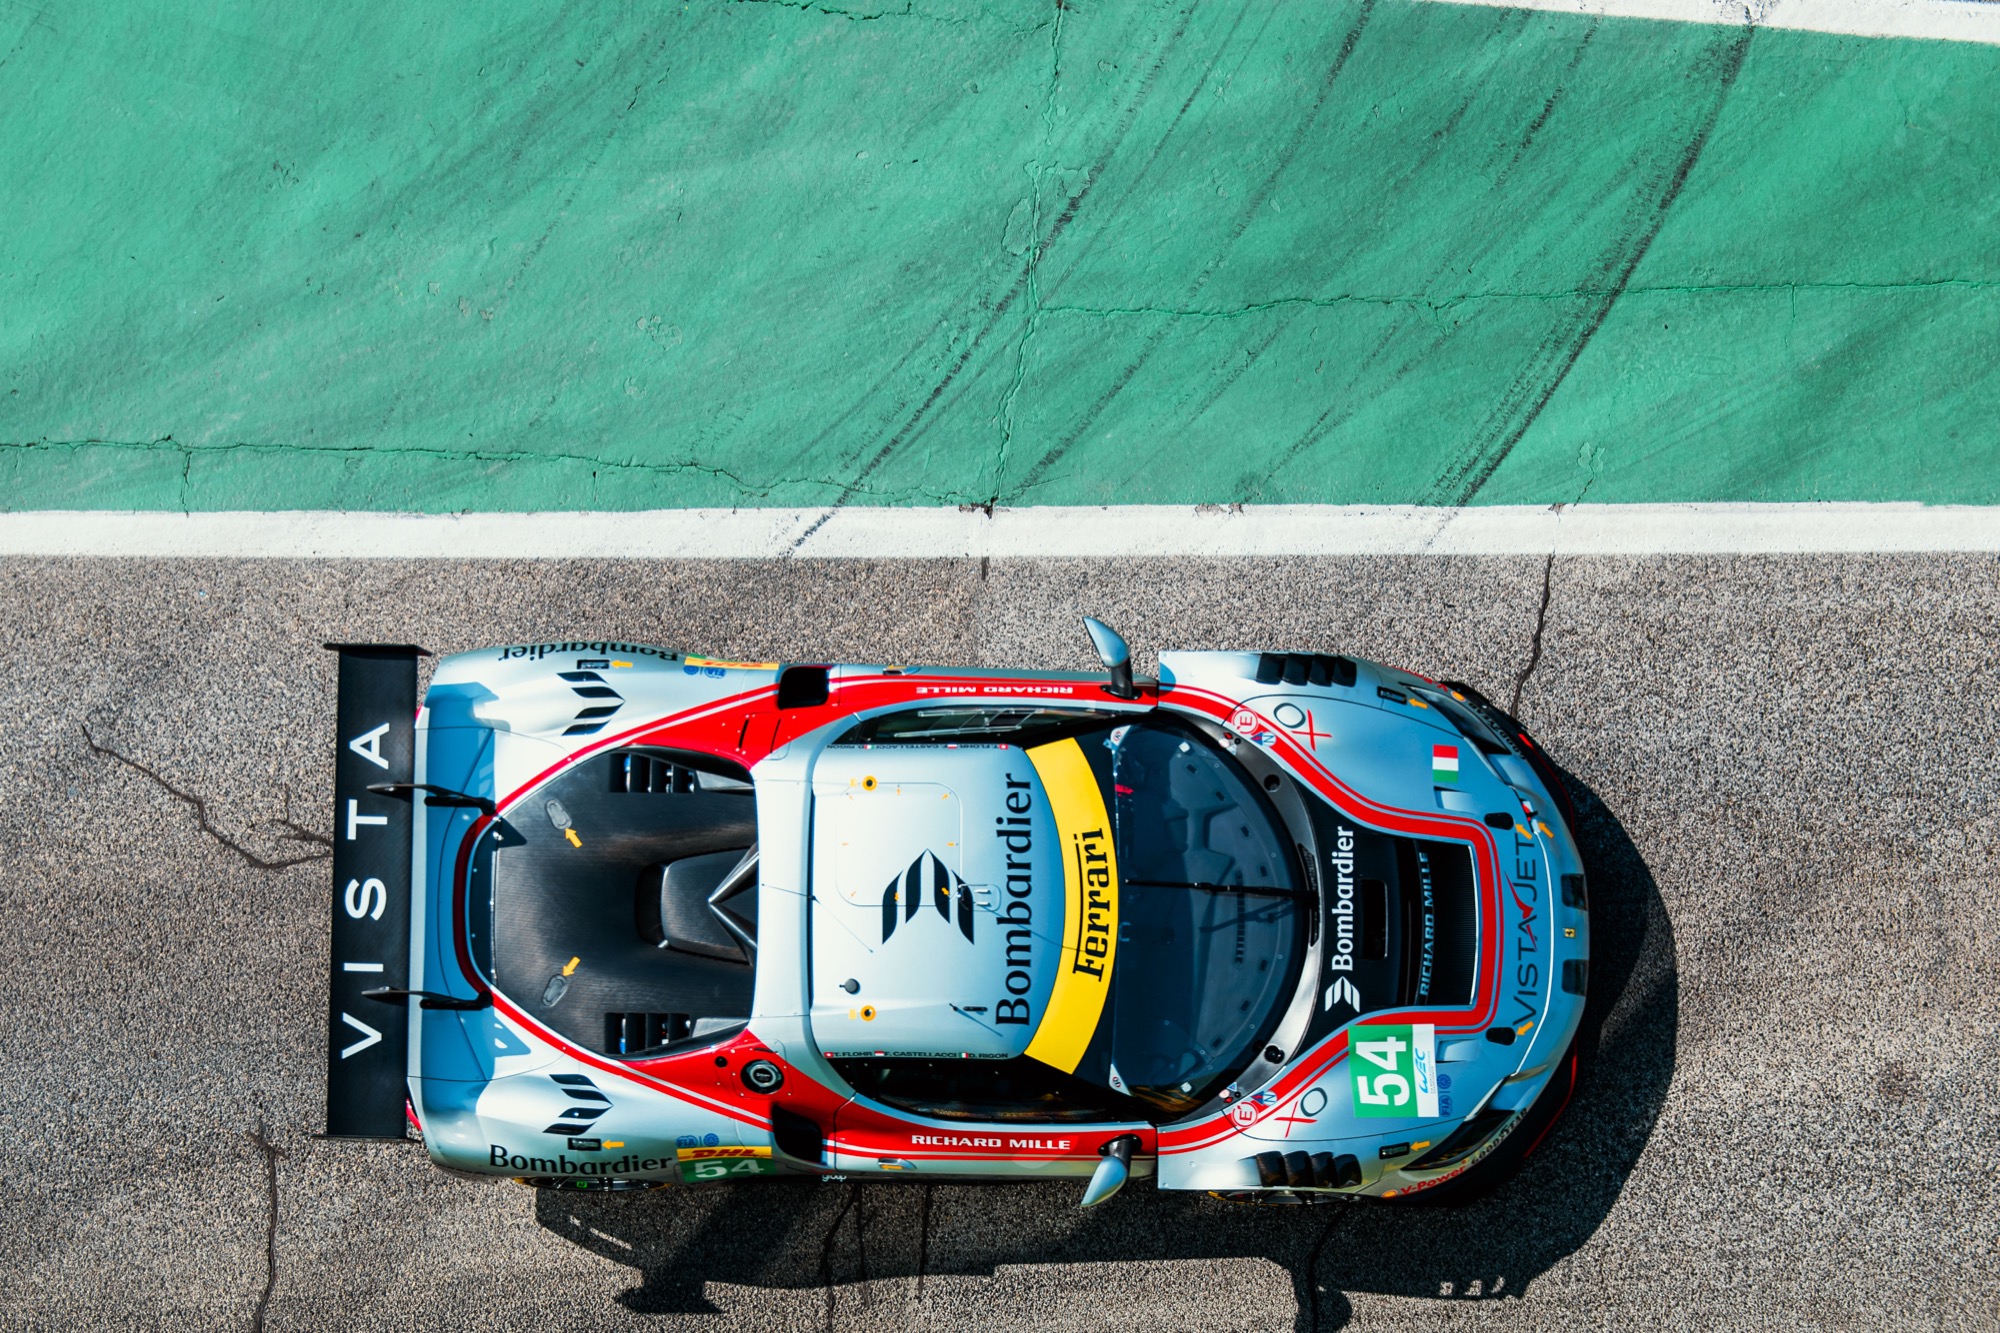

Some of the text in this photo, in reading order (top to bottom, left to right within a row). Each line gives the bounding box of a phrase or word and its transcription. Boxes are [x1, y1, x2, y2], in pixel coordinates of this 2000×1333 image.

[498, 641, 678, 662] Bombardier
[916, 686, 1073, 694] RICHARD MILLE
[341, 722, 390, 1060] VISTA
[995, 772, 1033, 1027] Bombardier
[1072, 827, 1111, 983] Ferrari
[1331, 825, 1354, 972] Bombardier
[1418, 851, 1435, 996] RICHARD MILLE
[1511, 832, 1539, 1026] VISTAJET
[1355, 1036, 1411, 1107] 54
[1414, 1047, 1429, 1094] WEC
[490, 1143, 673, 1176] Bombardier
[677, 1136, 697, 1147] FIA
[691, 1148, 756, 1159] DHL
[911, 1134, 1071, 1150] RICHARD MILLE
[1471, 1107, 1528, 1166] GOODYEAR
[695, 1159, 765, 1178] 54
[1400, 1164, 1467, 1195] V-Power
